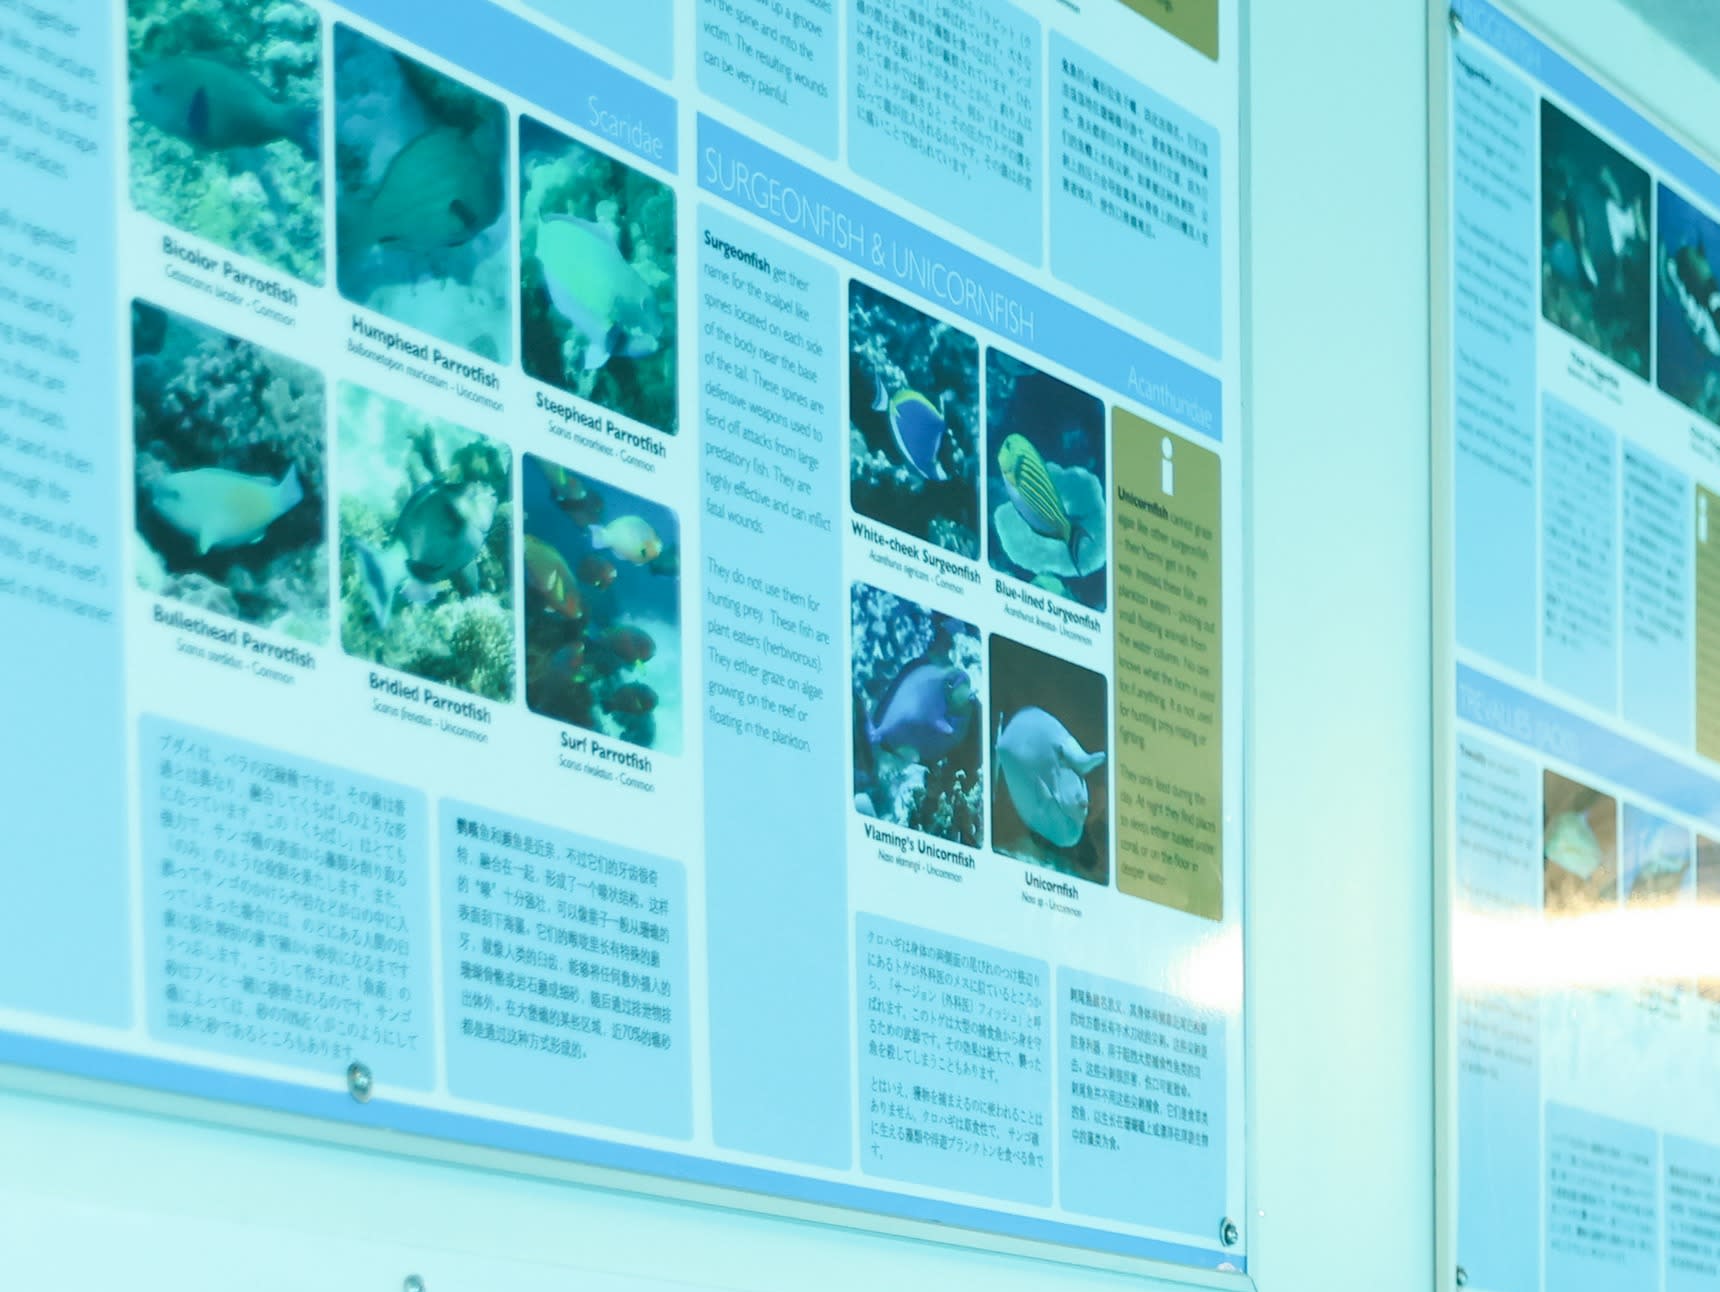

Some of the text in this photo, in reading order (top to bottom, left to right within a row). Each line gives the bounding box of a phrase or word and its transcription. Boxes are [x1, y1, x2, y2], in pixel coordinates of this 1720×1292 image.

[588, 96, 663, 160] Scaridae
[163, 236, 297, 306] Bicolor Parrotfish
[704, 147, 1035, 341] SURGEONFISH & UNICORNFISH
[704, 230, 771, 274] Surgeonfish
[352, 315, 500, 391] Humphead Parrotfish
[536, 391, 667, 459] Steephead Parrotfish
[851, 519, 981, 584] White-cheek Surgeonfish
[153, 603, 316, 670] Bullethead Parrotfish
[995, 579, 1101, 633] Blue-lined Surgeonfish
[424, 689, 492, 724] Parrotfish
[560, 731, 652, 773] Surf Parrotfish
[864, 823, 975, 870] Vlaming's Unicornfish
[1025, 871, 1079, 900] Unicornfish
